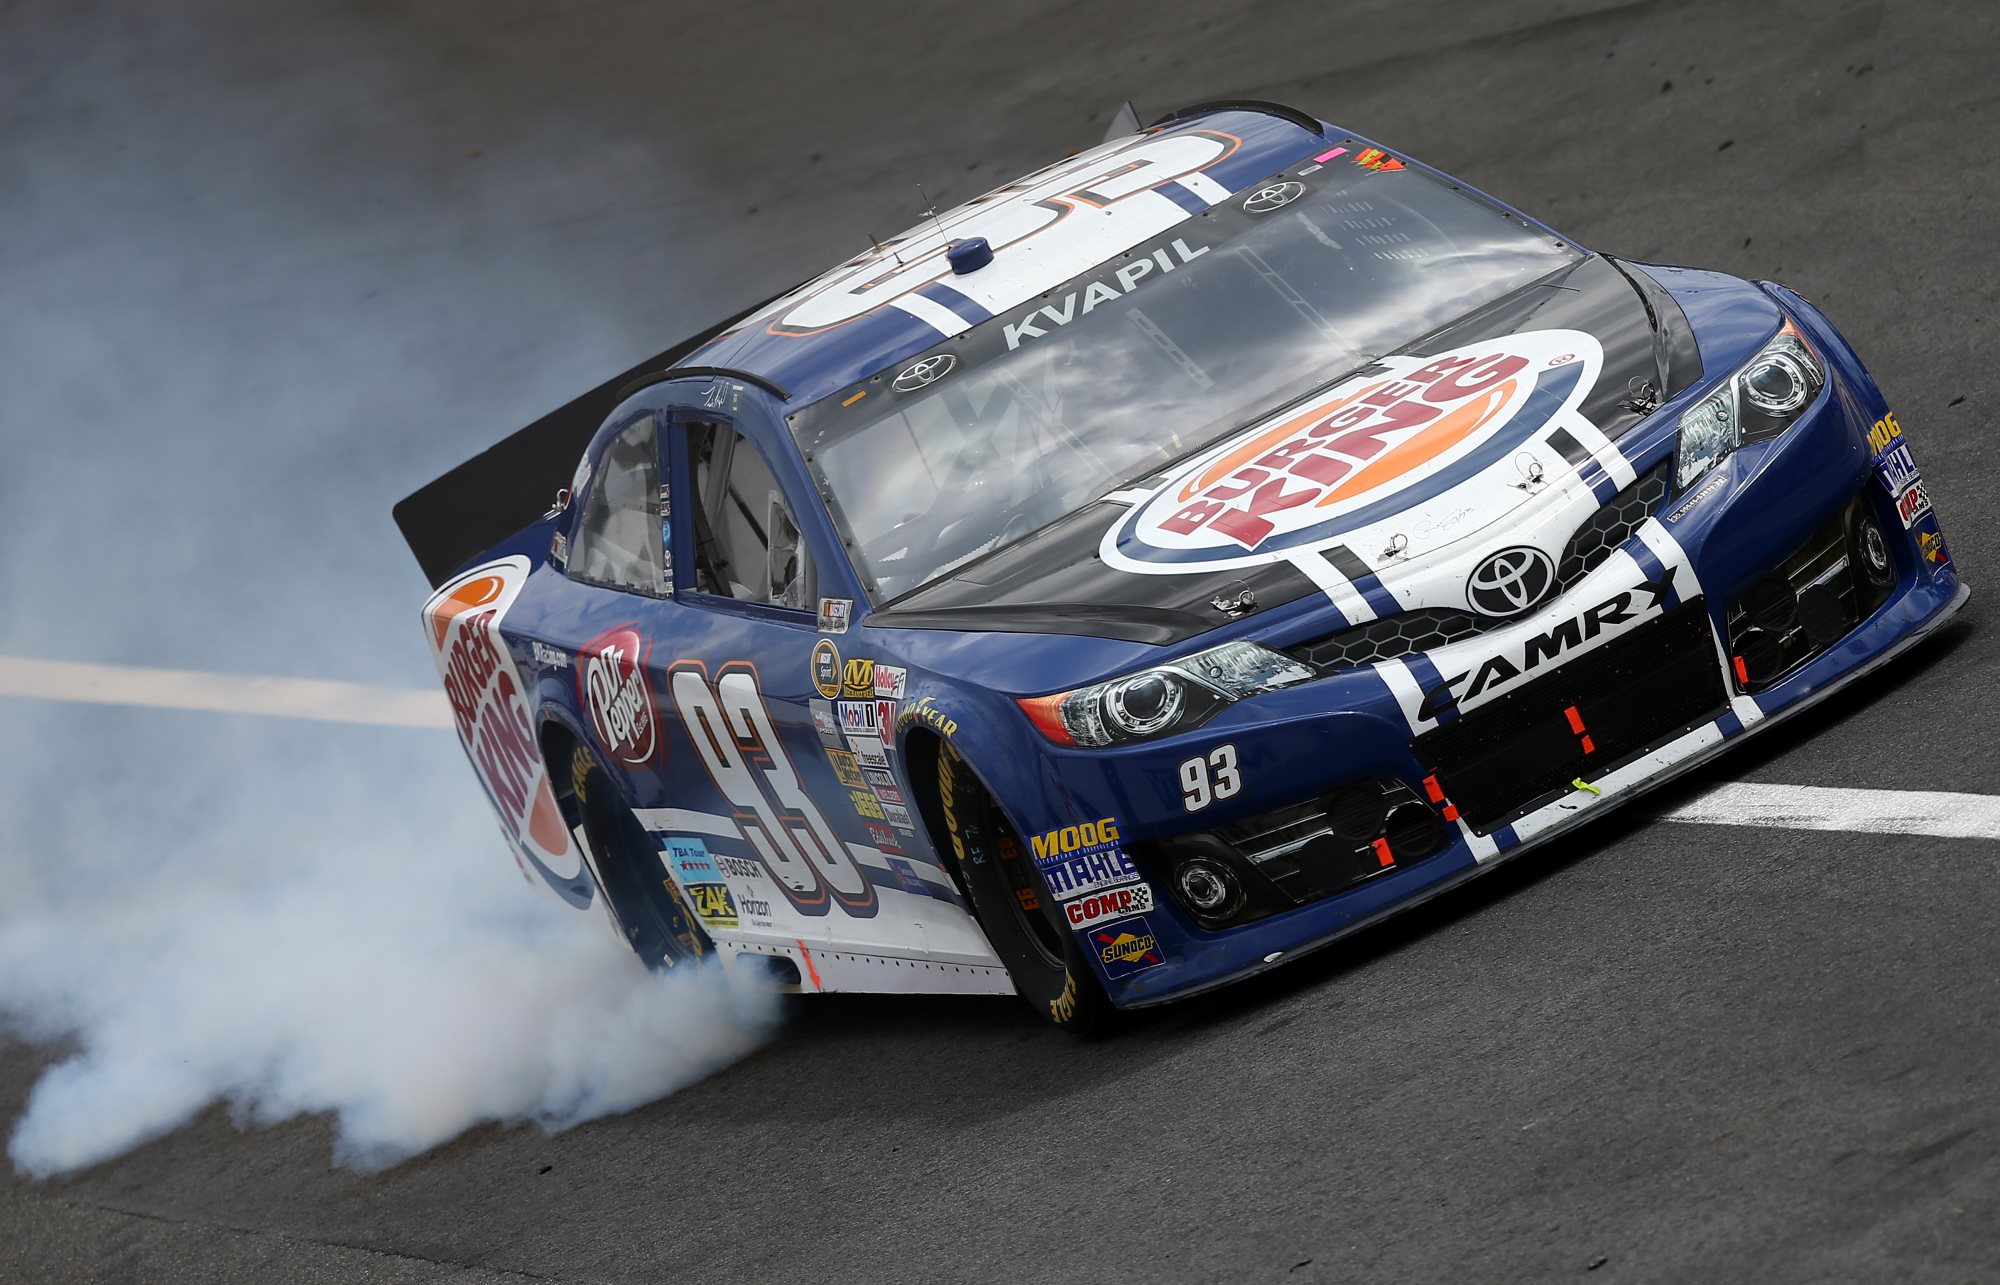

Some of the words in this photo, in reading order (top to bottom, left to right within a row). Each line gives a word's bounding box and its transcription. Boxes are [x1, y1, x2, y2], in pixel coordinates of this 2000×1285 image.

[1003, 238, 1210, 350] KVAPIL
[1157, 355, 1476, 535] BURGER
[1207, 353, 1529, 547] KING
[1418, 565, 1679, 722] CAMRY
[444, 609, 502, 748] BURGER
[600, 645, 624, 700] Dr
[587, 657, 643, 752] Pepper
[840, 703, 865, 727] Mobil
[476, 671, 540, 839] KING
[1179, 744, 1242, 813] 93
[670, 670, 868, 898] 93
[672, 848, 689, 858] TBA
[1031, 817, 1120, 860] MOOG
[724, 858, 763, 878] BOSCH
[1044, 848, 1138, 895] MAHLE
[688, 886, 736, 917] ZAK
[737, 894, 773, 917] Horizon
[1067, 890, 1132, 924] COMP
[1118, 903, 1147, 914] CAMS
[1104, 935, 1153, 963] SUNOCO
